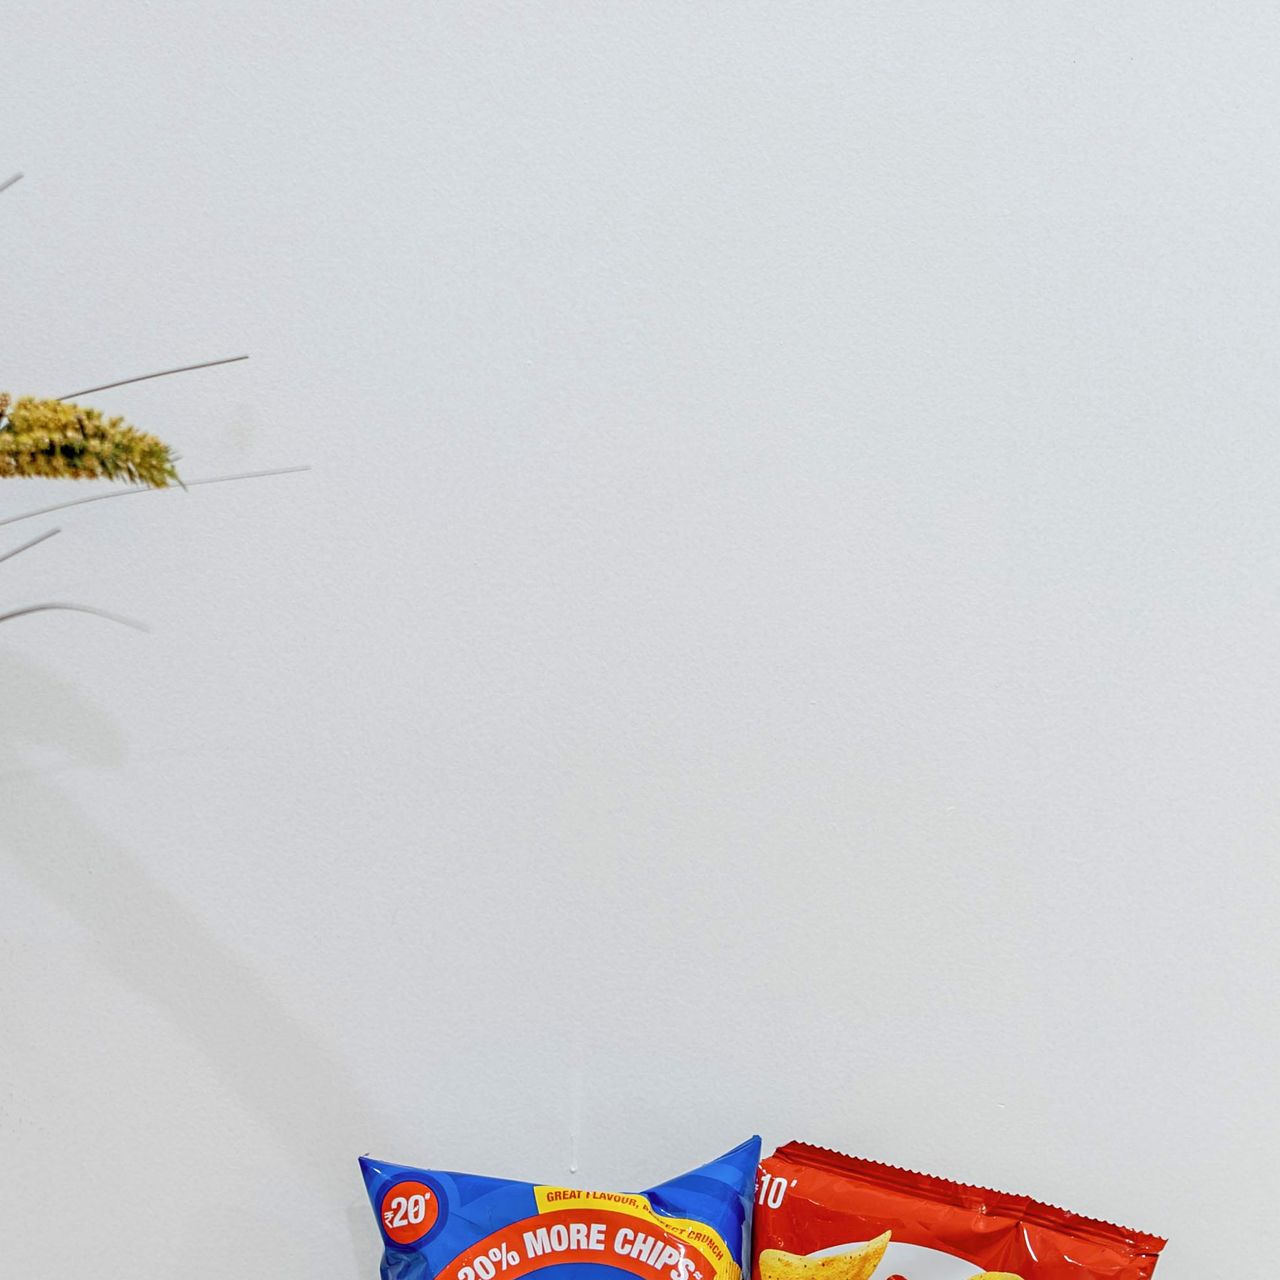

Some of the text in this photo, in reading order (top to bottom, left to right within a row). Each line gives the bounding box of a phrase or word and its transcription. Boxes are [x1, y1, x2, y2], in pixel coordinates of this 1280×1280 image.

[522, 1223, 606, 1259] MORE
[546, 1191, 582, 1202] GREAT
[687, 1230, 724, 1261] CRUNCH
